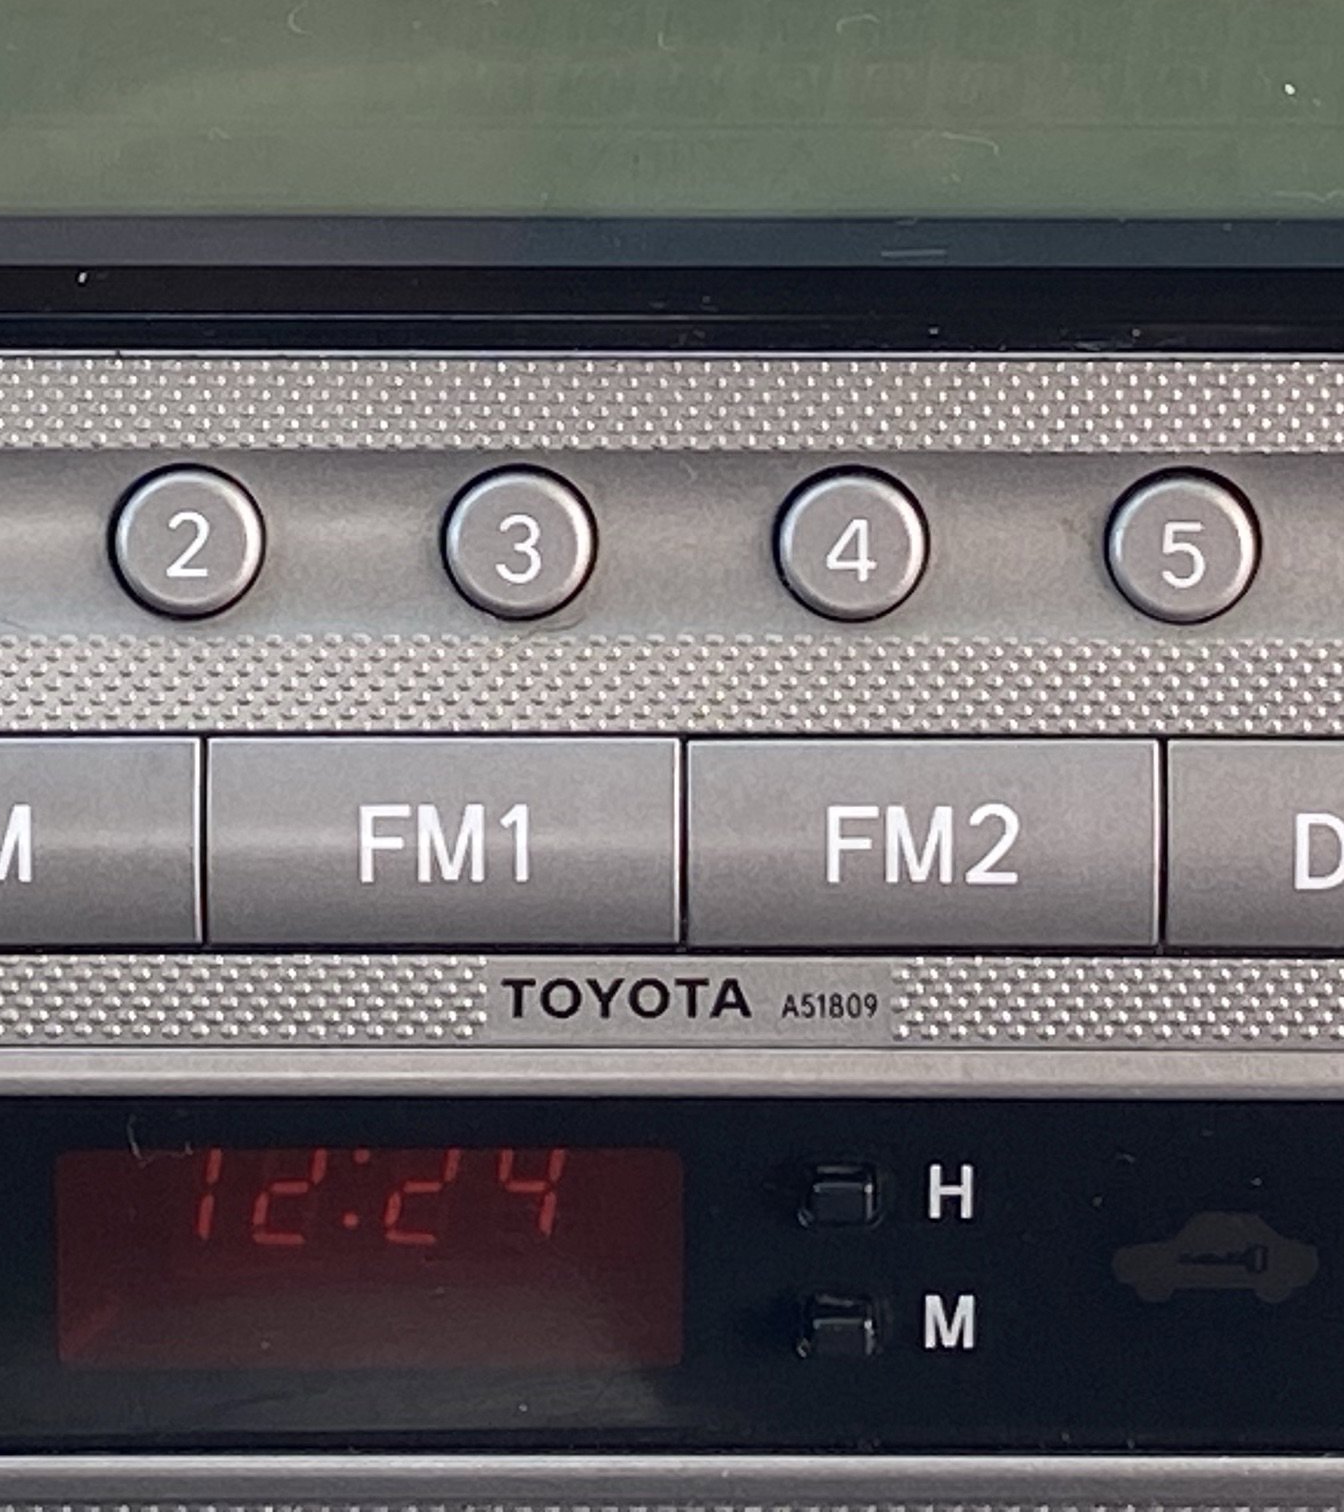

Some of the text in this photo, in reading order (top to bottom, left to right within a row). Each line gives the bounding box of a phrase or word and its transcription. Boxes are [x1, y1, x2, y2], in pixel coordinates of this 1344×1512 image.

[165, 512, 208, 579] 2
[495, 513, 543, 585] 3
[825, 517, 878, 583] 4
[1160, 521, 1206, 589] 5
[358, 802, 530, 883] FM1
[824, 803, 1020, 886] FM2
[501, 977, 878, 1019] TOYOTA A51809
[194, 1148, 567, 1245] 12:24
[927, 1163, 975, 1220] H
[923, 1294, 976, 1350] M
